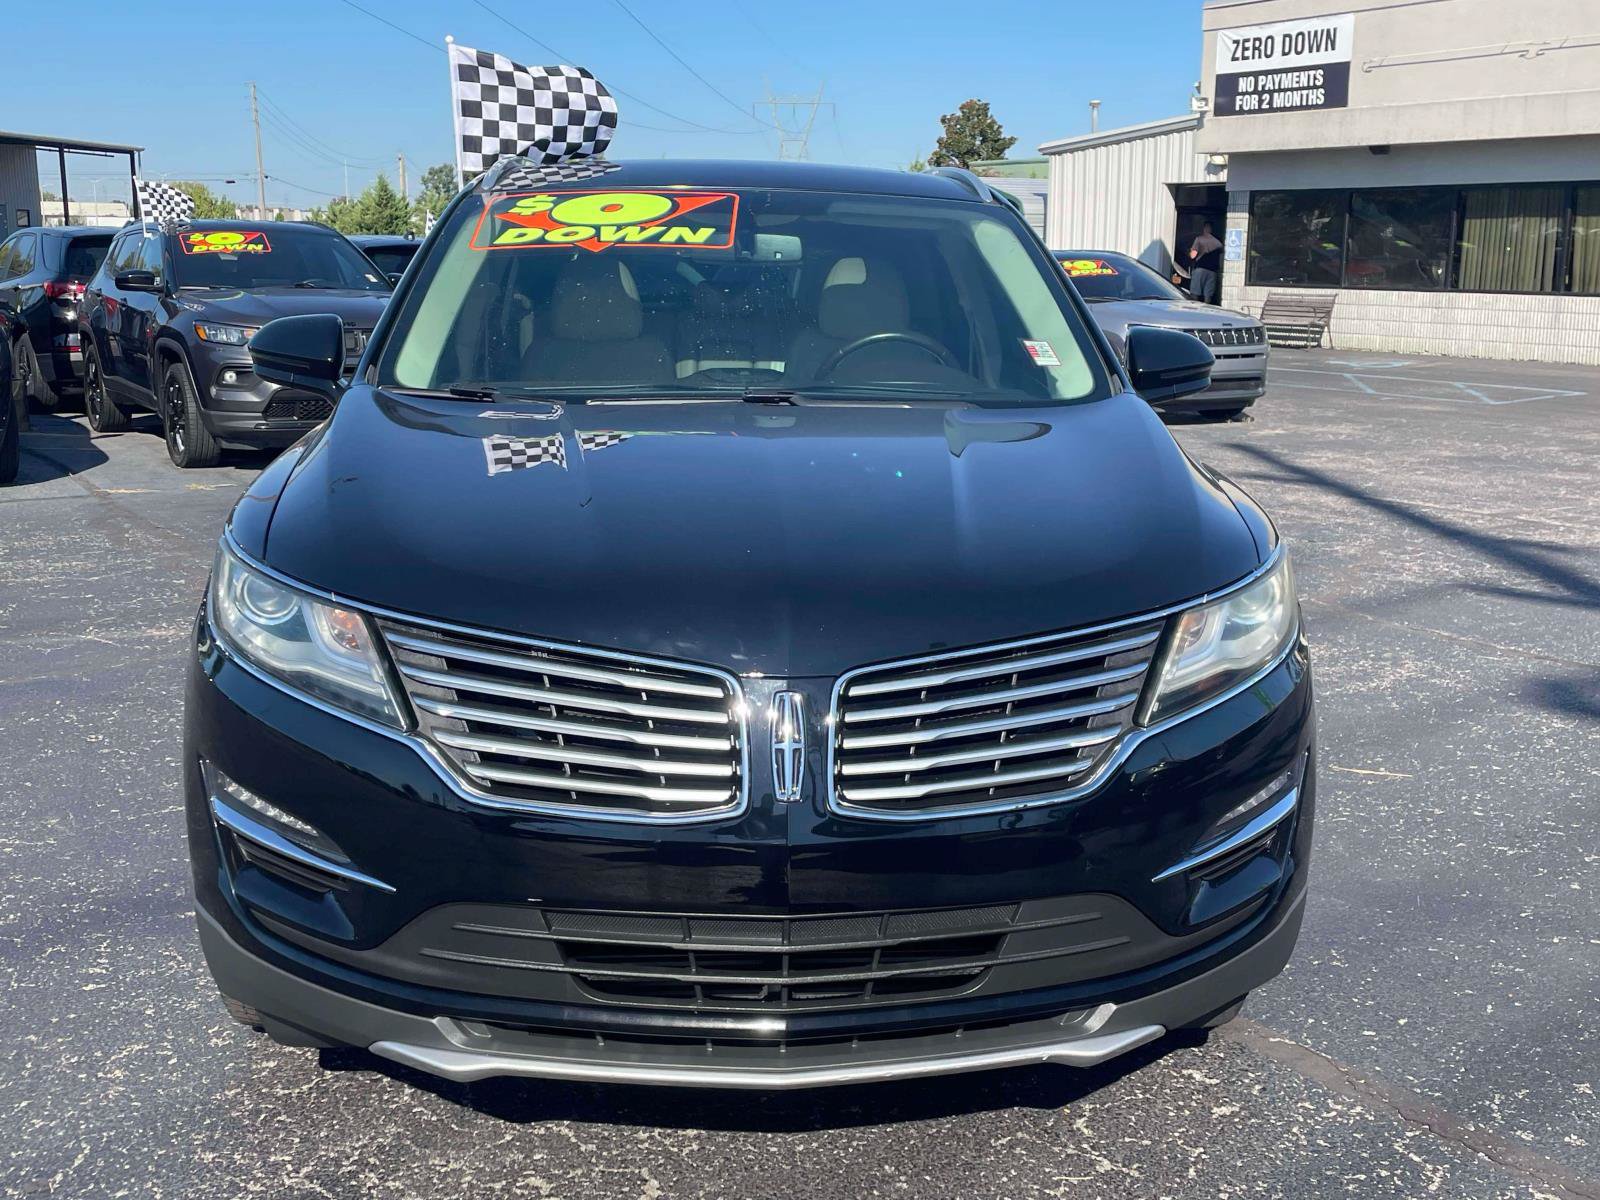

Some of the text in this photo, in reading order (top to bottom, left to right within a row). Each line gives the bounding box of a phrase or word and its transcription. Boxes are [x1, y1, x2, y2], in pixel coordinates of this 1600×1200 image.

[1231, 27, 1337, 62] ZERO DOWN
[1238, 69, 1324, 93] NO PAYMENTS
[1235, 88, 1325, 111] FOR 2 MONTHS
[493, 226, 716, 244] DOWN
[193, 244, 263, 252] DOWN
